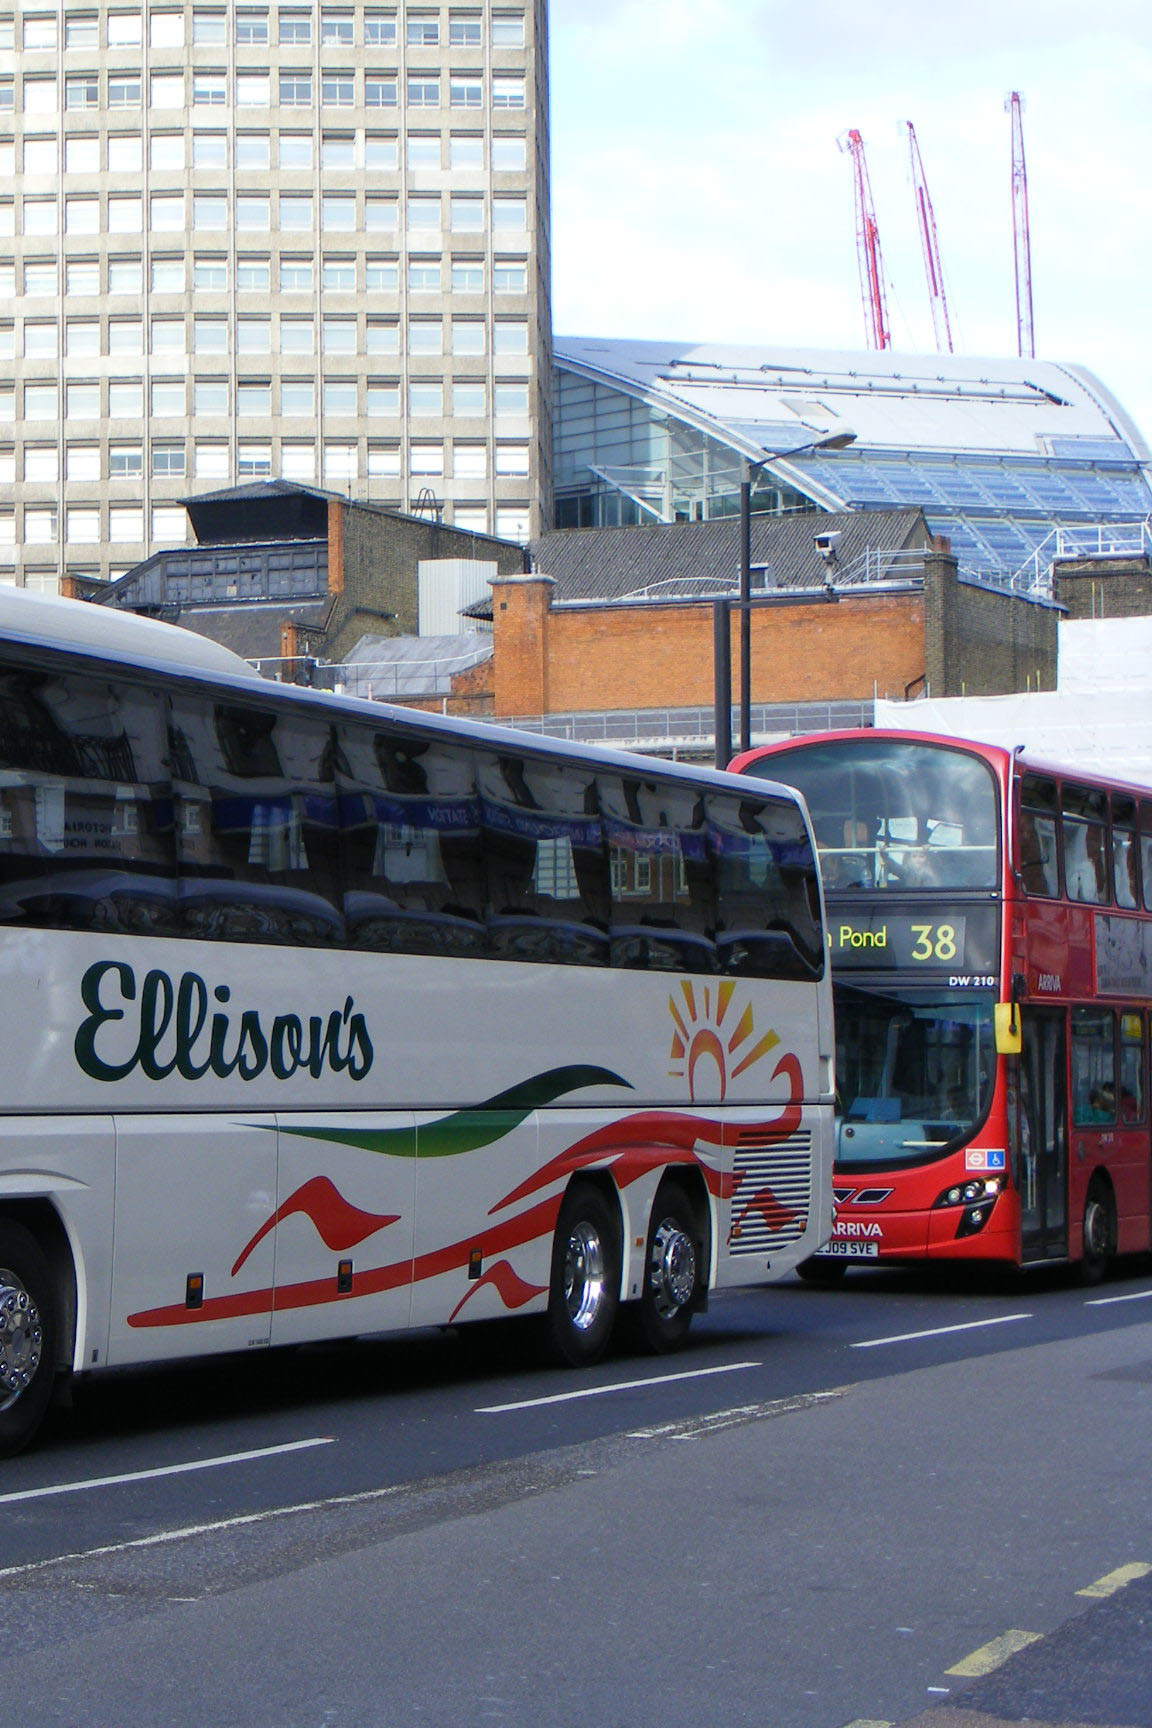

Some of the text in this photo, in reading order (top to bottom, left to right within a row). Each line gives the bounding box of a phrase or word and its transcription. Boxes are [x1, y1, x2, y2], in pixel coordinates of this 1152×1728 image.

[839, 925, 887, 947] Pond
[910, 924, 957, 960] 38
[949, 976, 995, 986] DW 210
[1038, 974, 1062, 992] ARRIVA
[74, 960, 374, 1082] Ellison's
[850, 1242, 873, 1255] SVE
